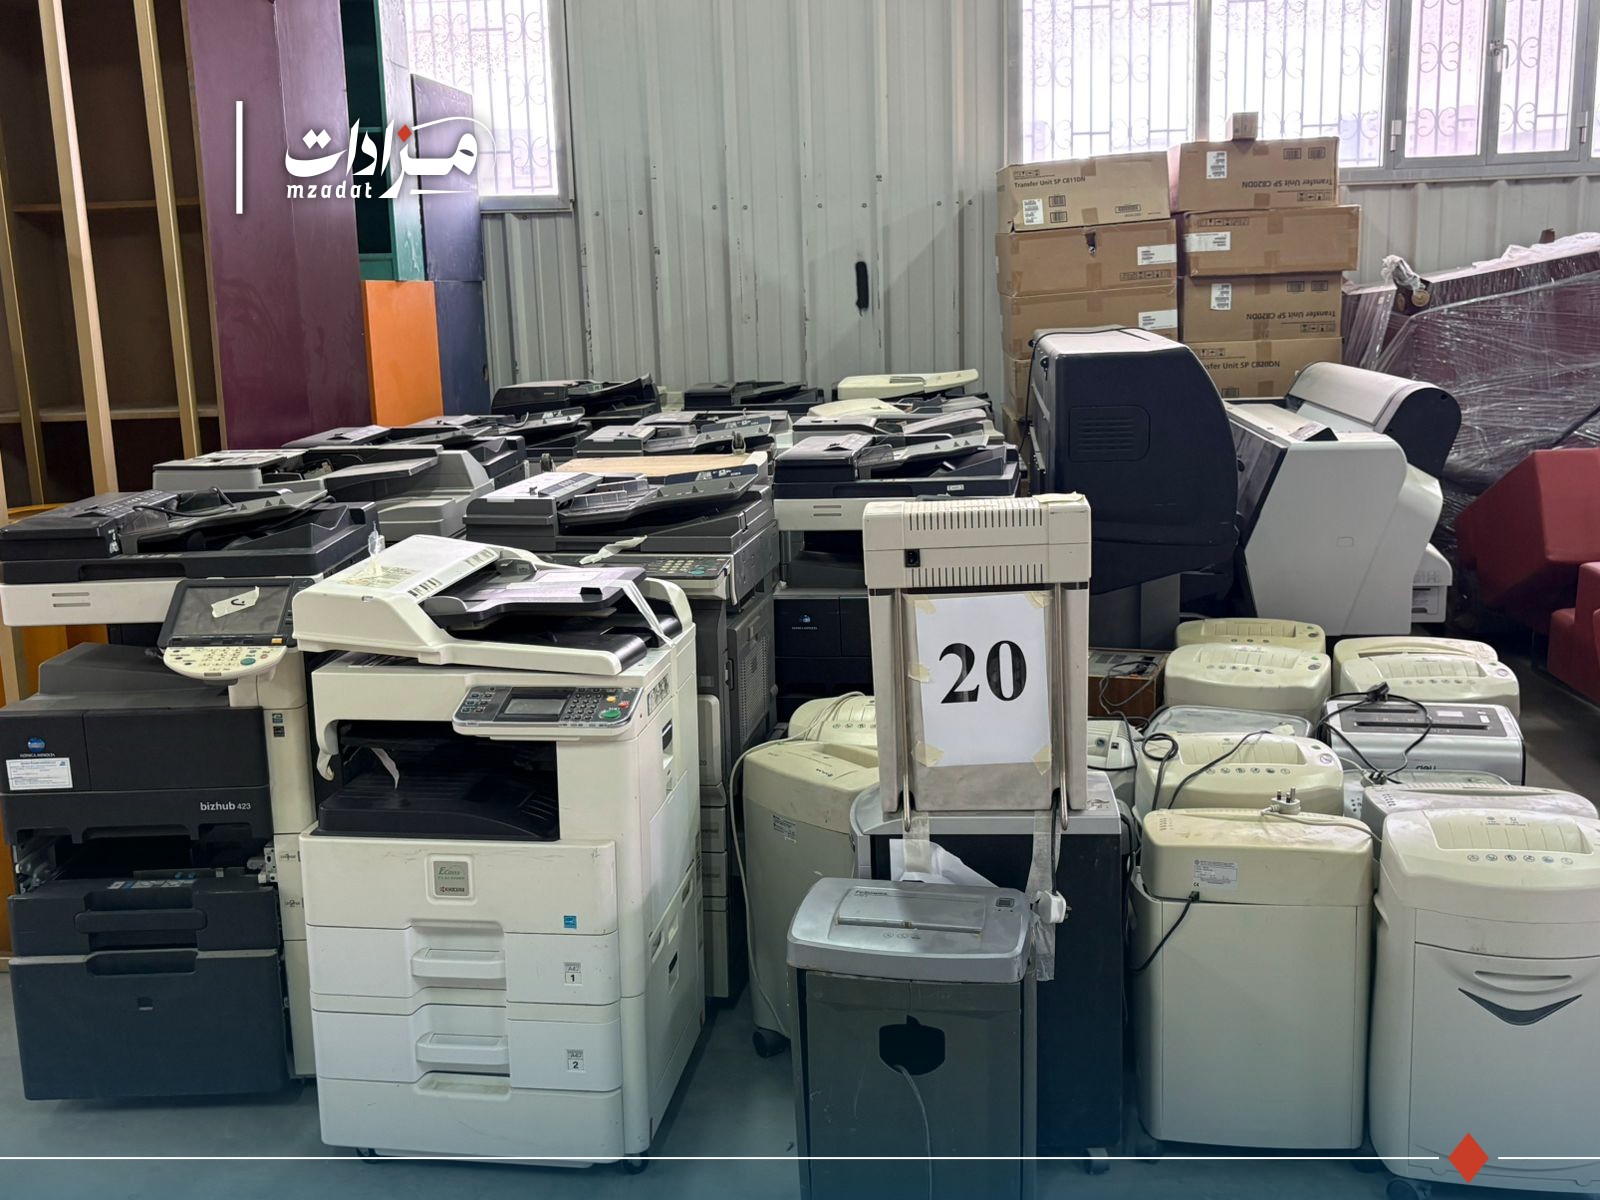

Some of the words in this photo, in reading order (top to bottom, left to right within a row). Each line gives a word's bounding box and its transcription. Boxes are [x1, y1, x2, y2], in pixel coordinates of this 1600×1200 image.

[1014, 181, 1038, 189] Transfer
[1039, 179, 1053, 187] Unit
[1272, 180, 1283, 188] SP
[1284, 180, 1301, 188] Unit
[1303, 179, 1333, 188] Transfer
[1276, 312, 1286, 320] SP
[1287, 311, 1304, 319] Unit
[1305, 310, 1337, 319] Transfer
[1222, 361, 1239, 370] Unit
[1239, 361, 1250, 369] SP
[938, 640, 1027, 704] 20
[200, 801, 236, 811] bizhub
[237, 802, 251, 810] 423
[570, 974, 575, 982] 1
[572, 1061, 579, 1069] 2
